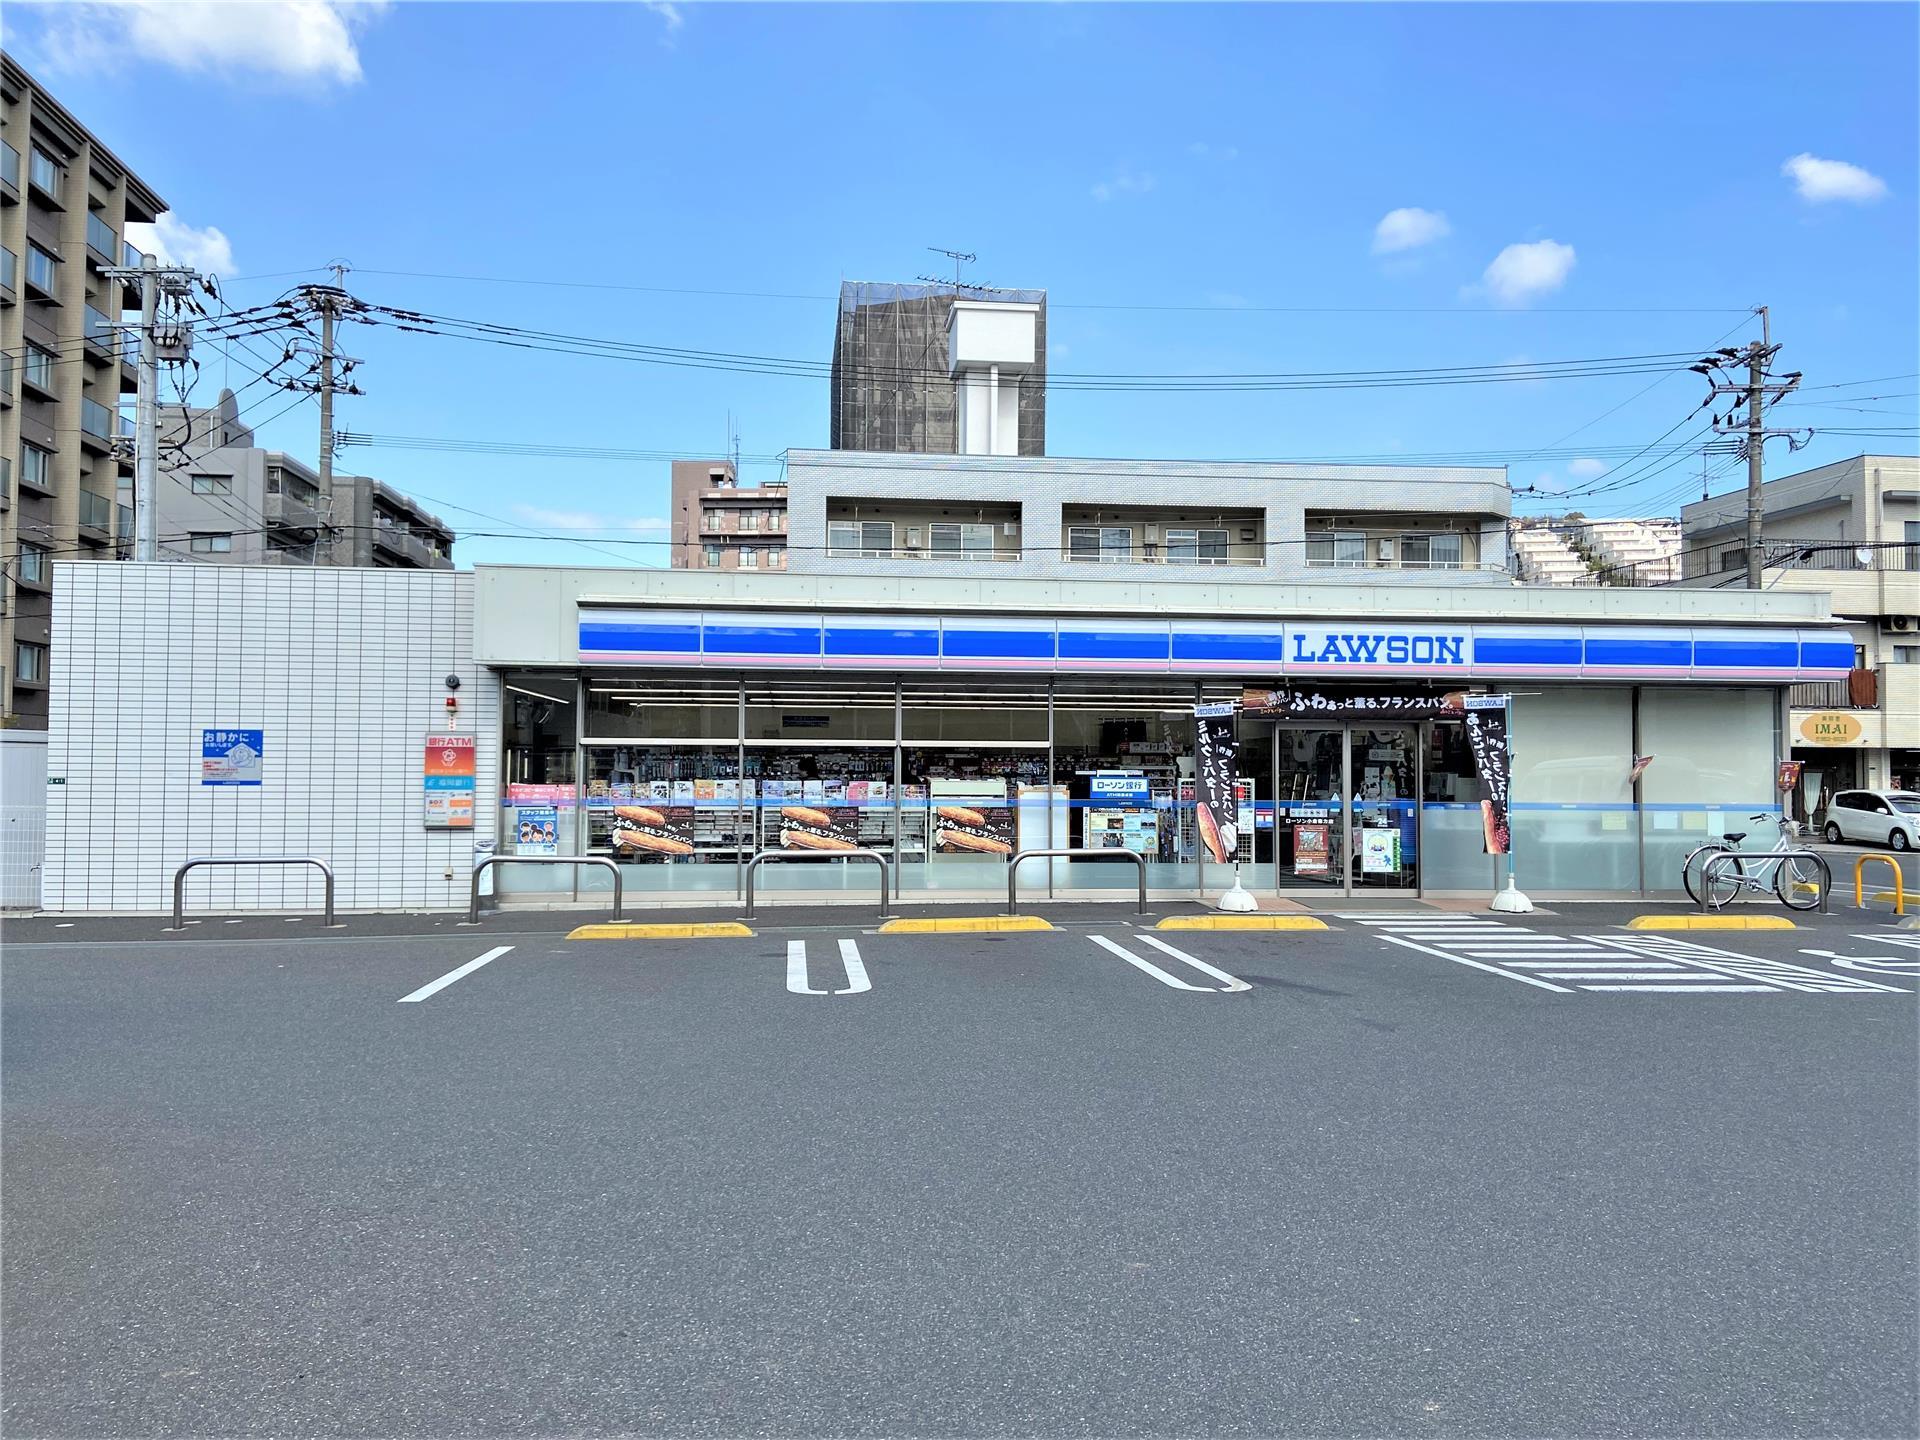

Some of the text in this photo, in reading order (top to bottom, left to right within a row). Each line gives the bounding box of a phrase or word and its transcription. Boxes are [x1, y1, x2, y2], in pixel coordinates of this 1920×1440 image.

[1293, 634, 1464, 664] LAWSON
[1815, 723, 1847, 734] IMAI
[428, 737, 472, 746] 銀行ATM
[1097, 781, 1143, 790] ローソン銀行
